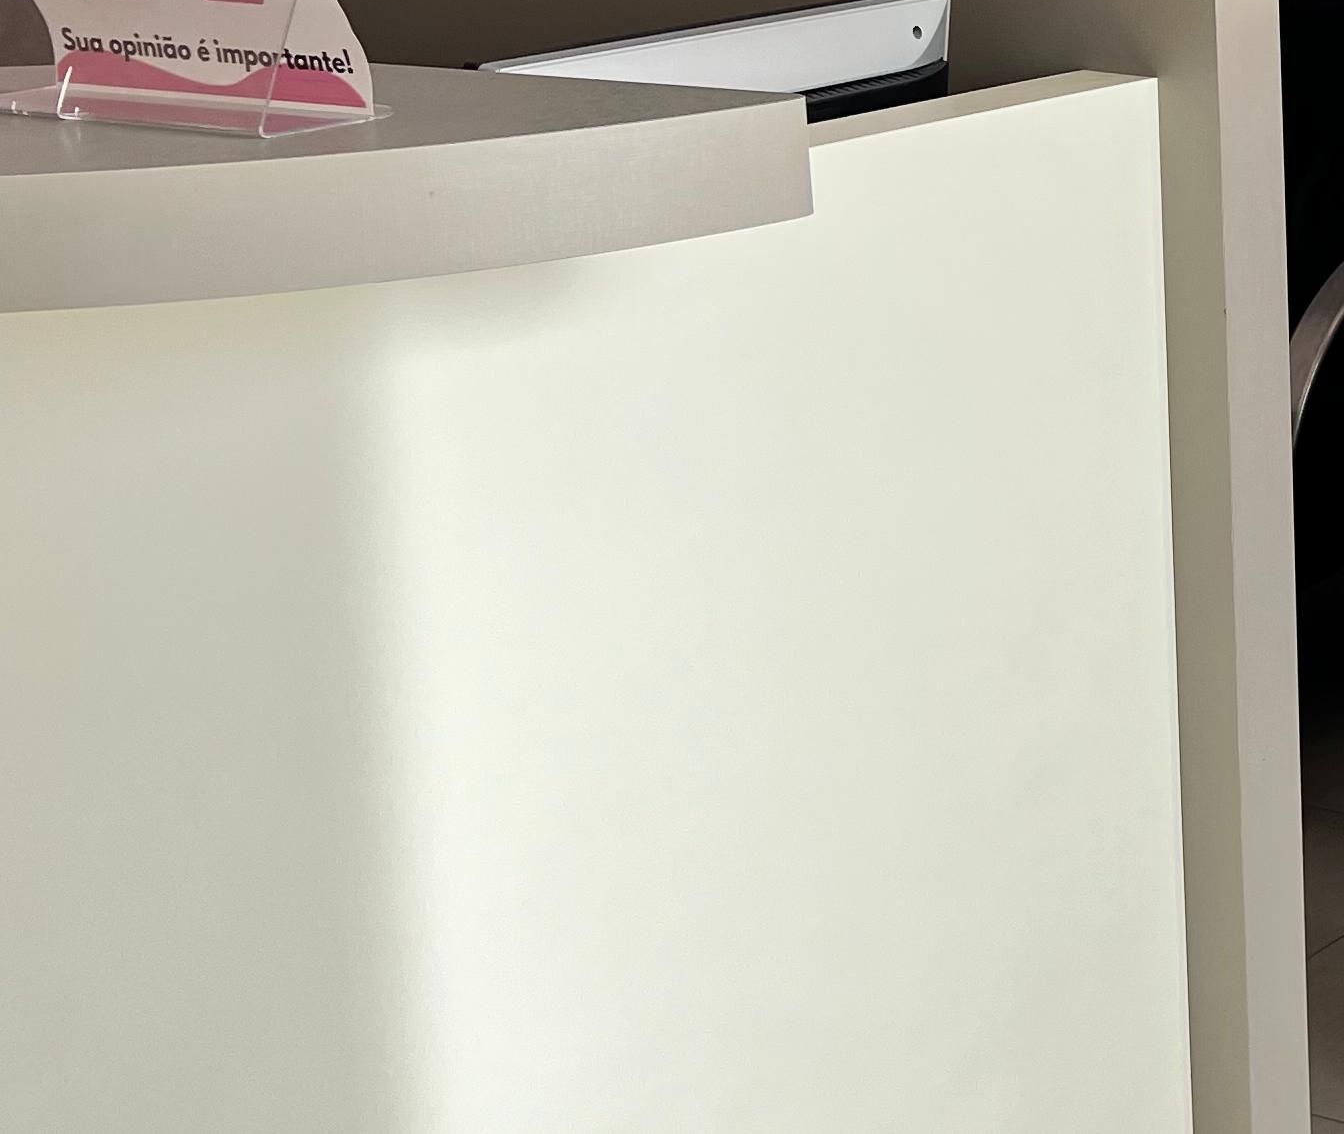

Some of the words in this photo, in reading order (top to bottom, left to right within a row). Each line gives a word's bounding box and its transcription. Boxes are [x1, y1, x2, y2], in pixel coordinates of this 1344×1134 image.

[62, 27, 103, 52] Sua
[109, 34, 192, 62] opinião
[197, 40, 210, 61] é
[217, 40, 354, 74] importante!
